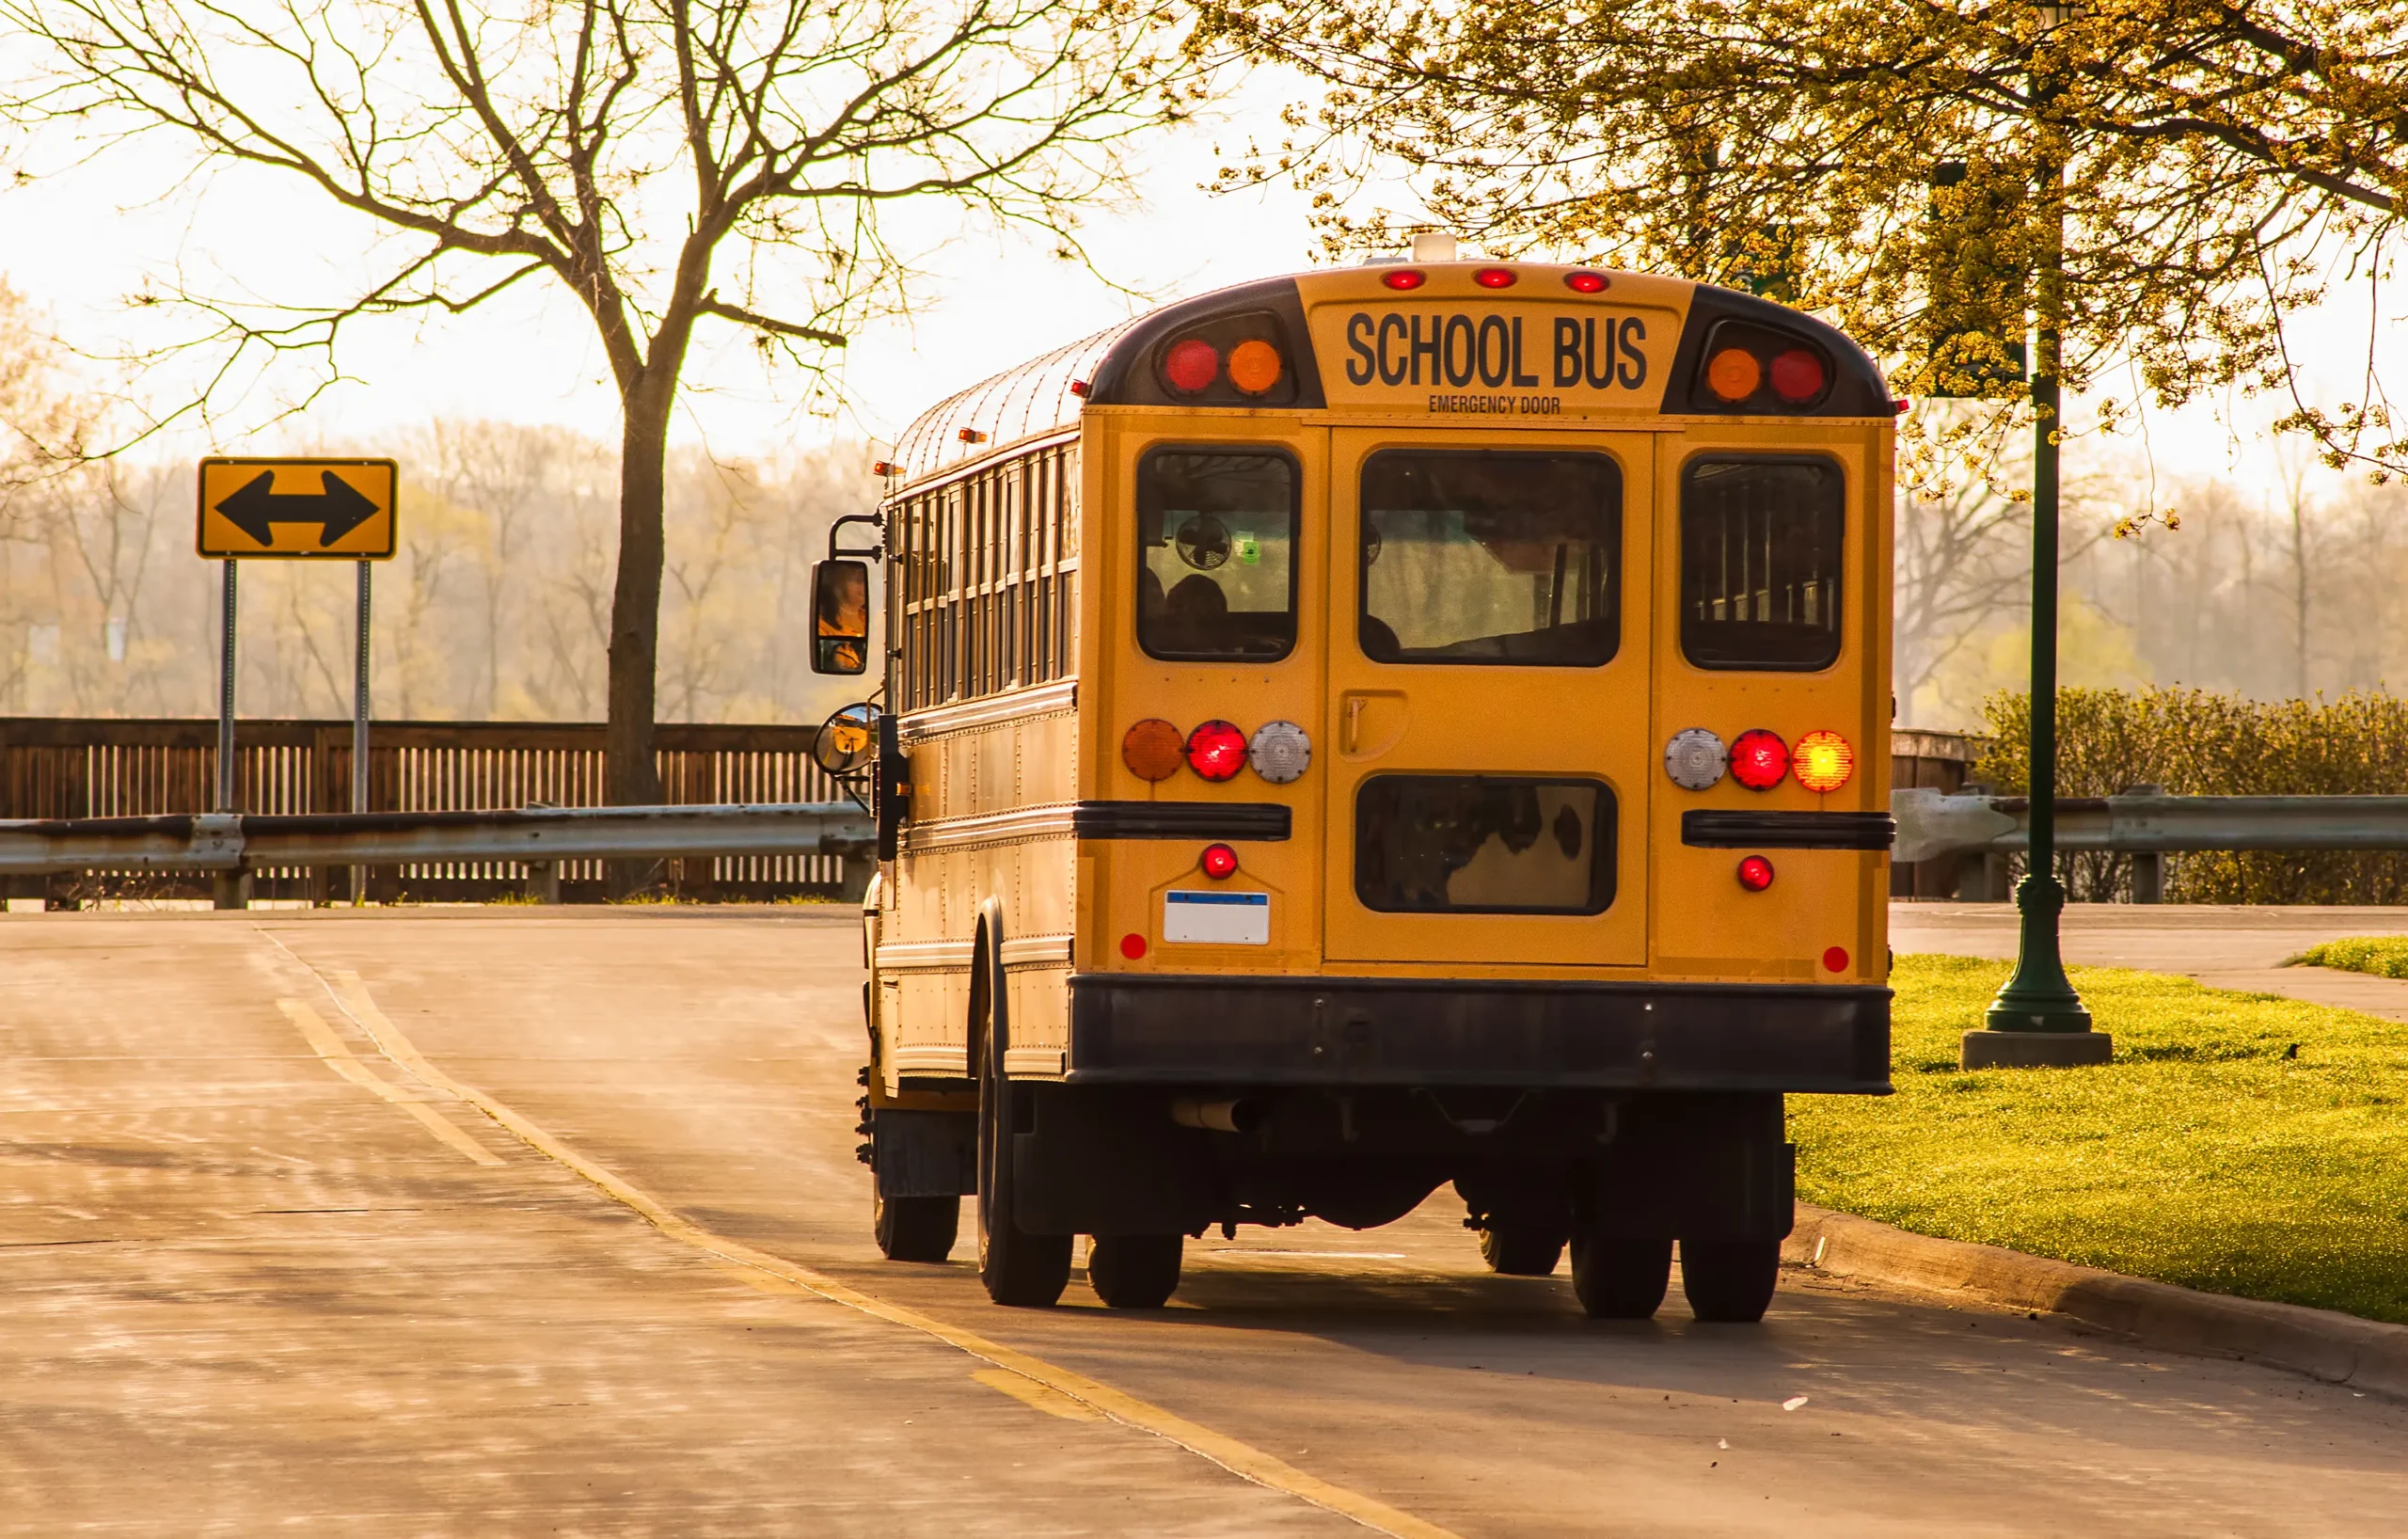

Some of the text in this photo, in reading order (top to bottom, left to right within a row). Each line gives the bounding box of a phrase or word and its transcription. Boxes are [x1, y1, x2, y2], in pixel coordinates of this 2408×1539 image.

[1346, 312, 1647, 389] SCHOOL BUS
[1429, 395, 1561, 415] EMERGENCY DOOR
